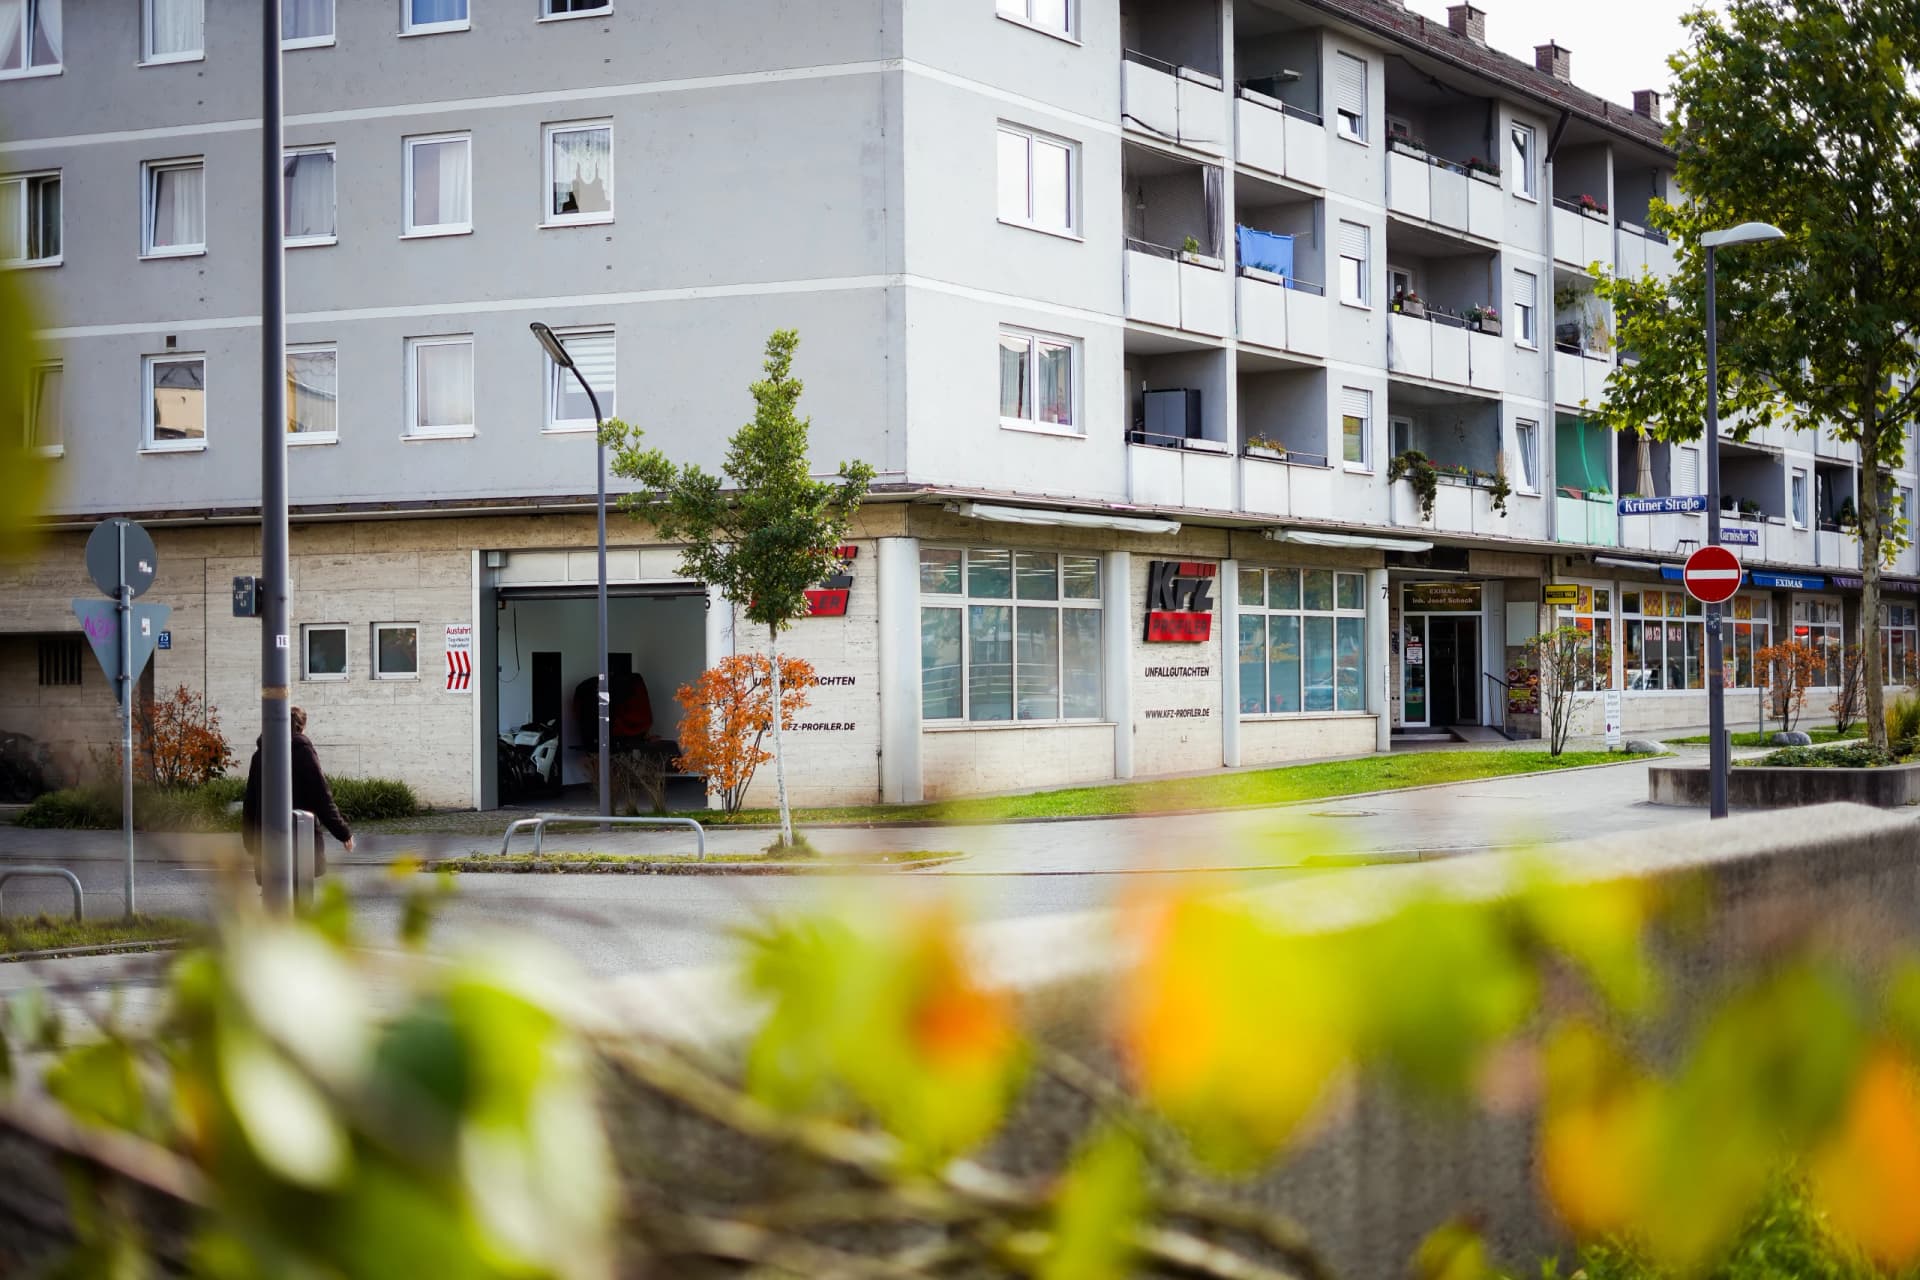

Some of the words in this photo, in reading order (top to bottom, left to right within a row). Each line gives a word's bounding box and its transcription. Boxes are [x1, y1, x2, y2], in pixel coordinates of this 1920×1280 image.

[1625, 499, 1662, 512] Krüner
[1665, 497, 1700, 511] Straße
[1775, 578, 1803, 589] EXIMAS
[447, 626, 471, 635] Ausfahrt
[1152, 618, 1208, 635] PROFILER
[160, 632, 169, 642] 75
[1144, 666, 1210, 678] UNFALLGUTACHTEN
[1145, 708, 1211, 719] WWW.KFZ-PROFILER.DE
